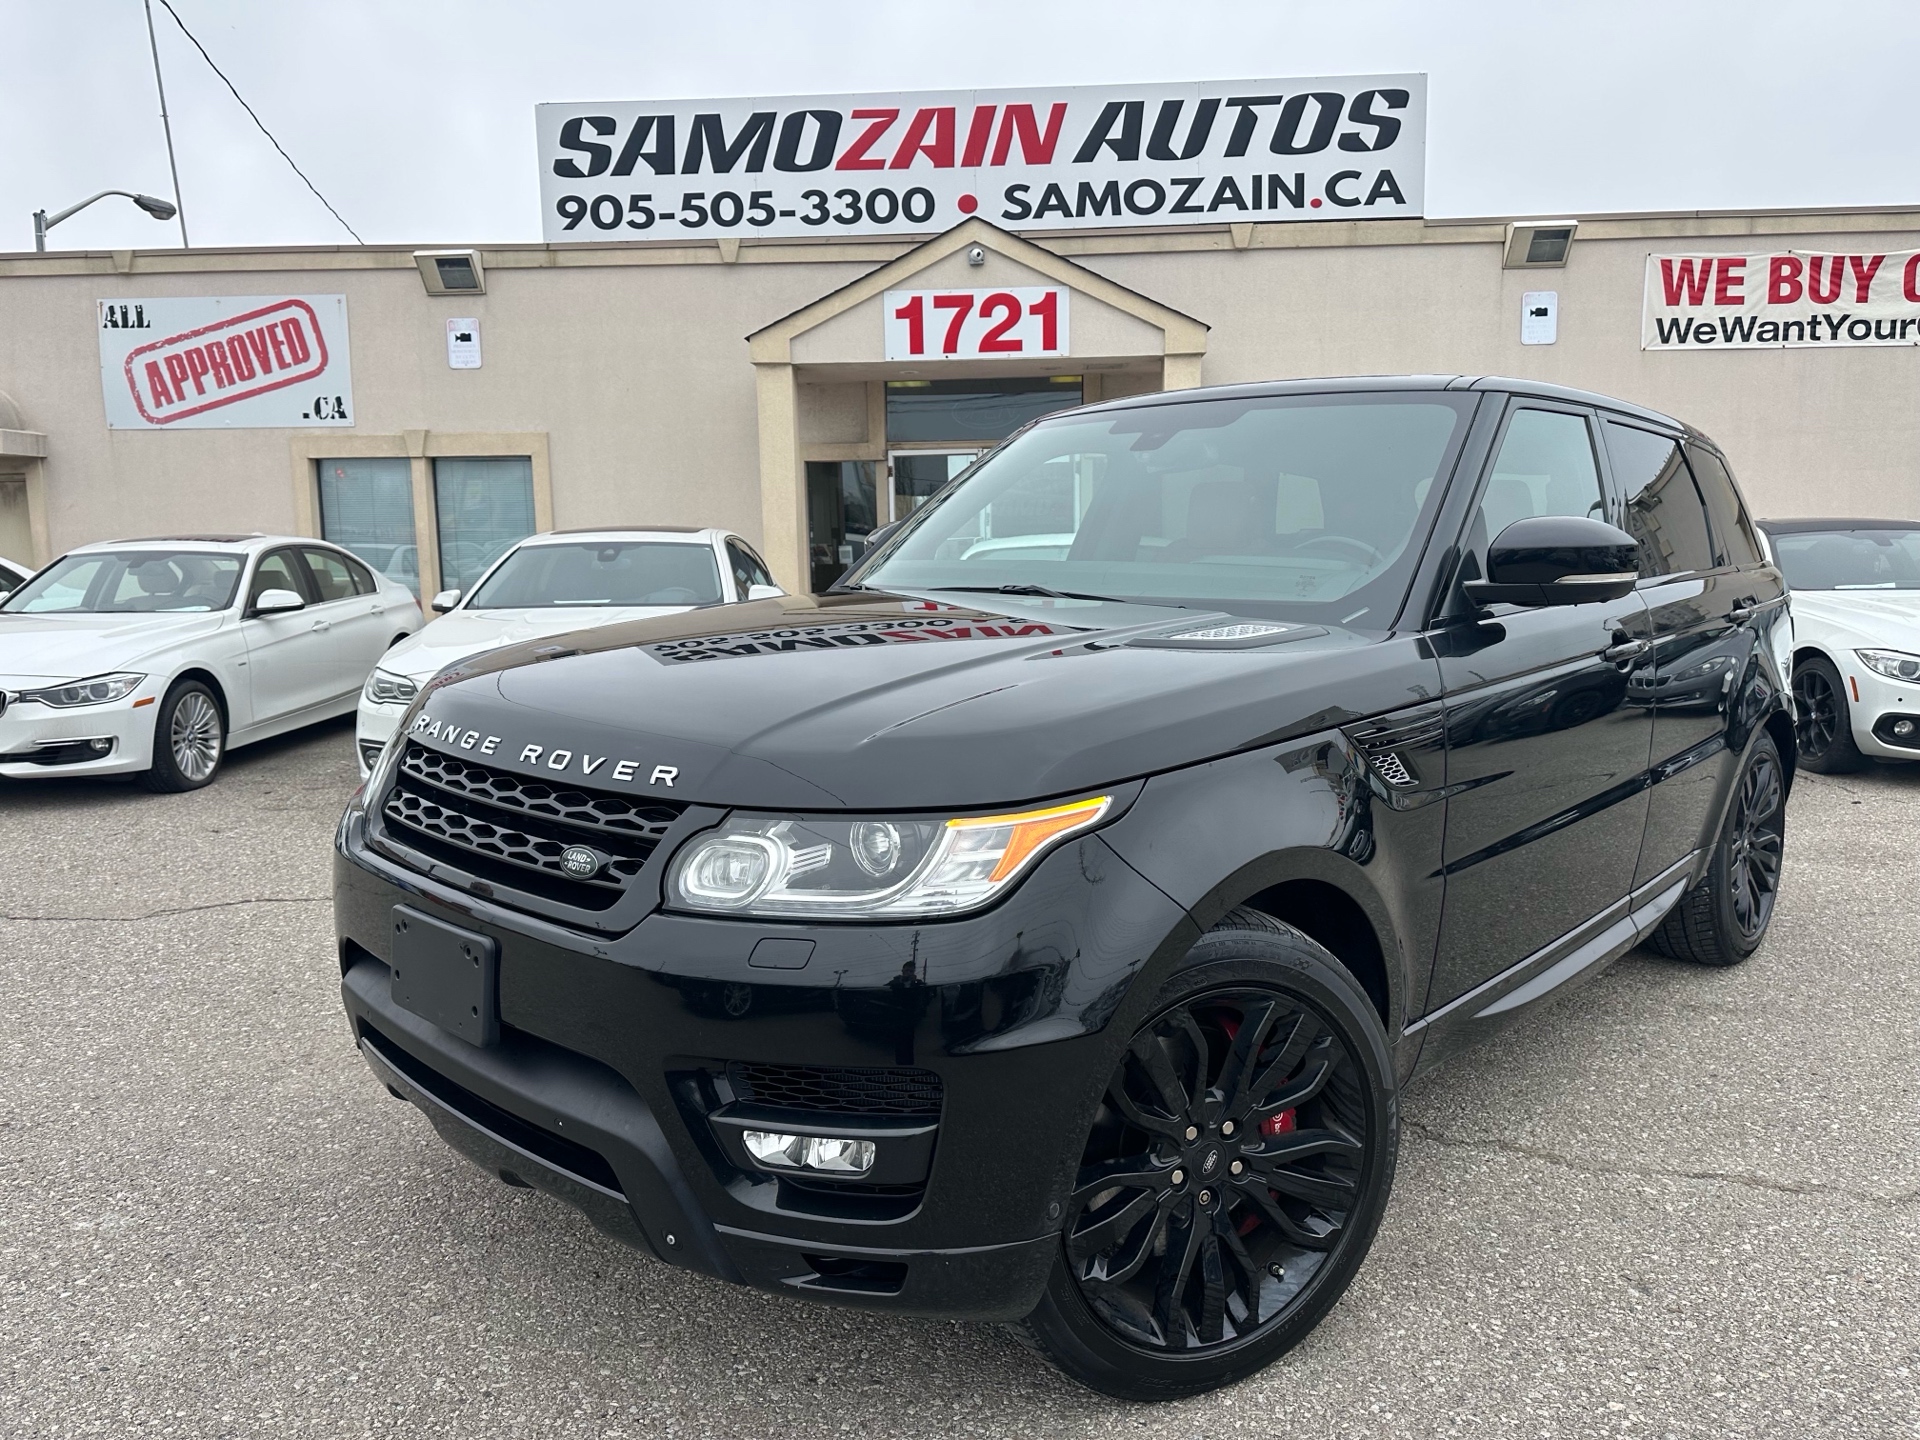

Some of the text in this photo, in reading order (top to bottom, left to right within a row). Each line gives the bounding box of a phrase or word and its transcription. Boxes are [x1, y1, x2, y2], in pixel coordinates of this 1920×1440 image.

[553, 89, 1410, 178] SAMOZAIN AUTOS
[556, 169, 1407, 231] 905-505-3300 SAMOZAIN.CA
[1659, 257, 1747, 306] WE
[1767, 255, 1885, 305] BUY
[103, 304, 151, 329] ALL
[894, 291, 1058, 355] 1721
[1655, 313, 1920, 345] WeWantYour
[145, 317, 310, 407] APPROVED
[415, 714, 679, 787] RANGE ROVER
[567, 850, 588, 863] LAND
[567, 860, 591, 874] ROVER
